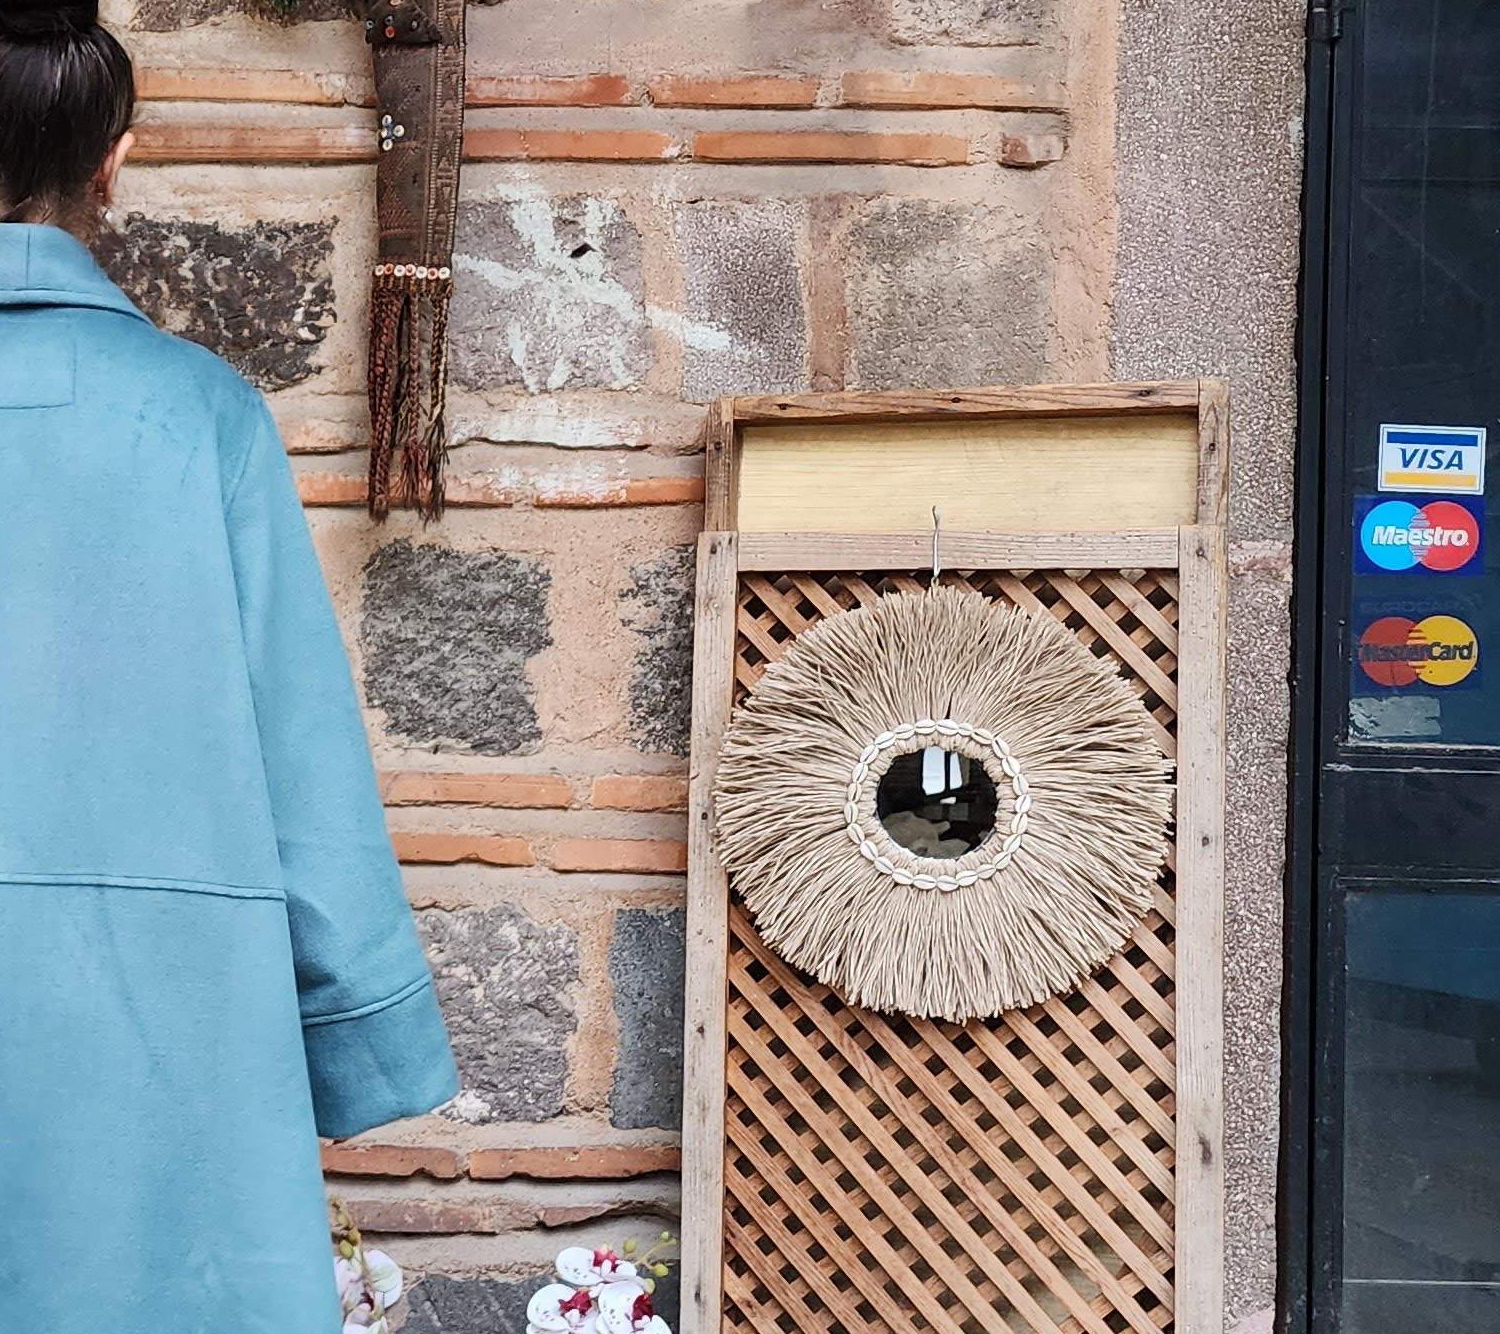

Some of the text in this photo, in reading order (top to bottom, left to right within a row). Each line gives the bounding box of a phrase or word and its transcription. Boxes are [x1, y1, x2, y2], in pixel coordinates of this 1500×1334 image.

[1398, 447, 1464, 471] VISA
[1372, 525, 1469, 547] Maestro
[1358, 640, 1474, 662] MasterCard
